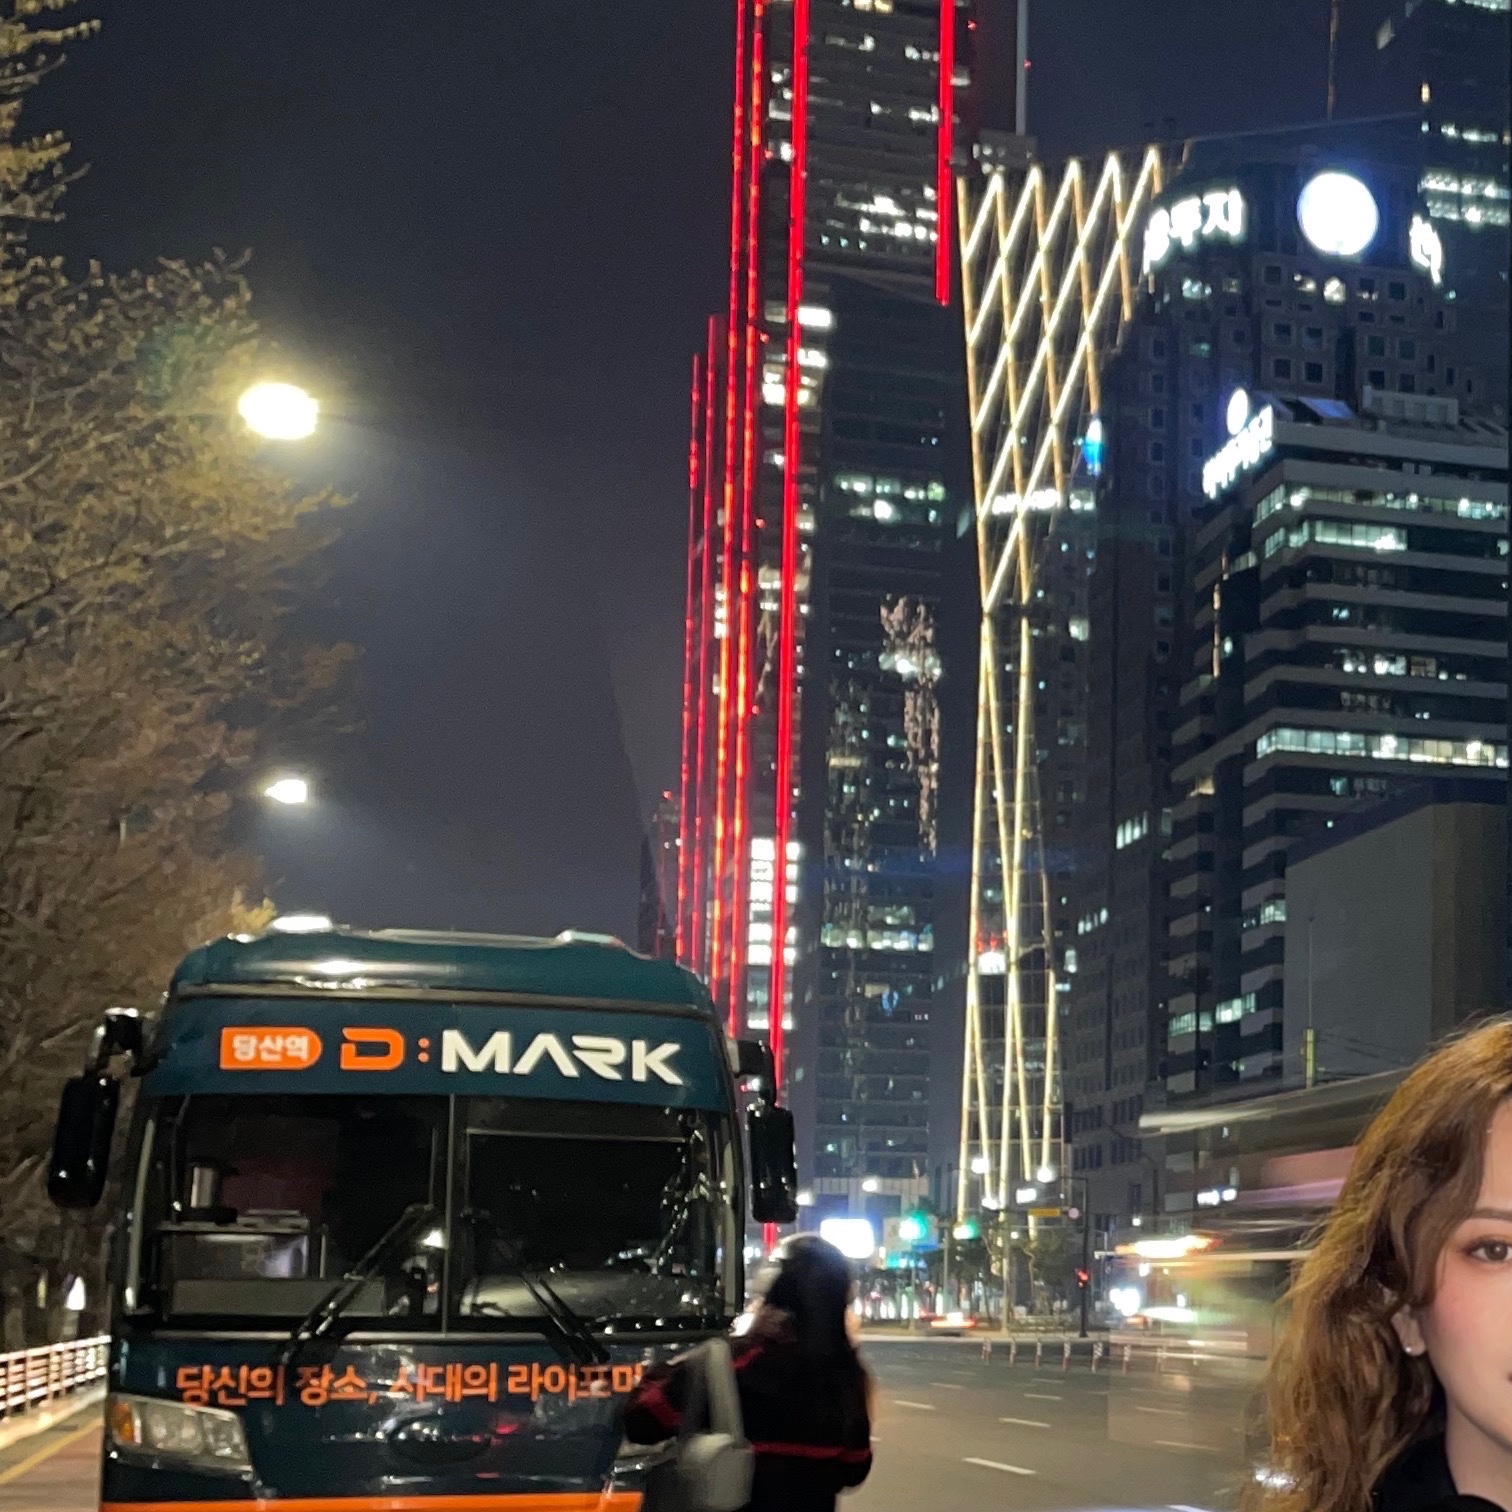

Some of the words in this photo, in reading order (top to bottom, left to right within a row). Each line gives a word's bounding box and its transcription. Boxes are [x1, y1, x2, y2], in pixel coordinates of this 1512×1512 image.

[232, 1034, 309, 1063] 당산역
[175, 1364, 284, 1406] 당신의
[296, 1363, 377, 1405] 장소,
